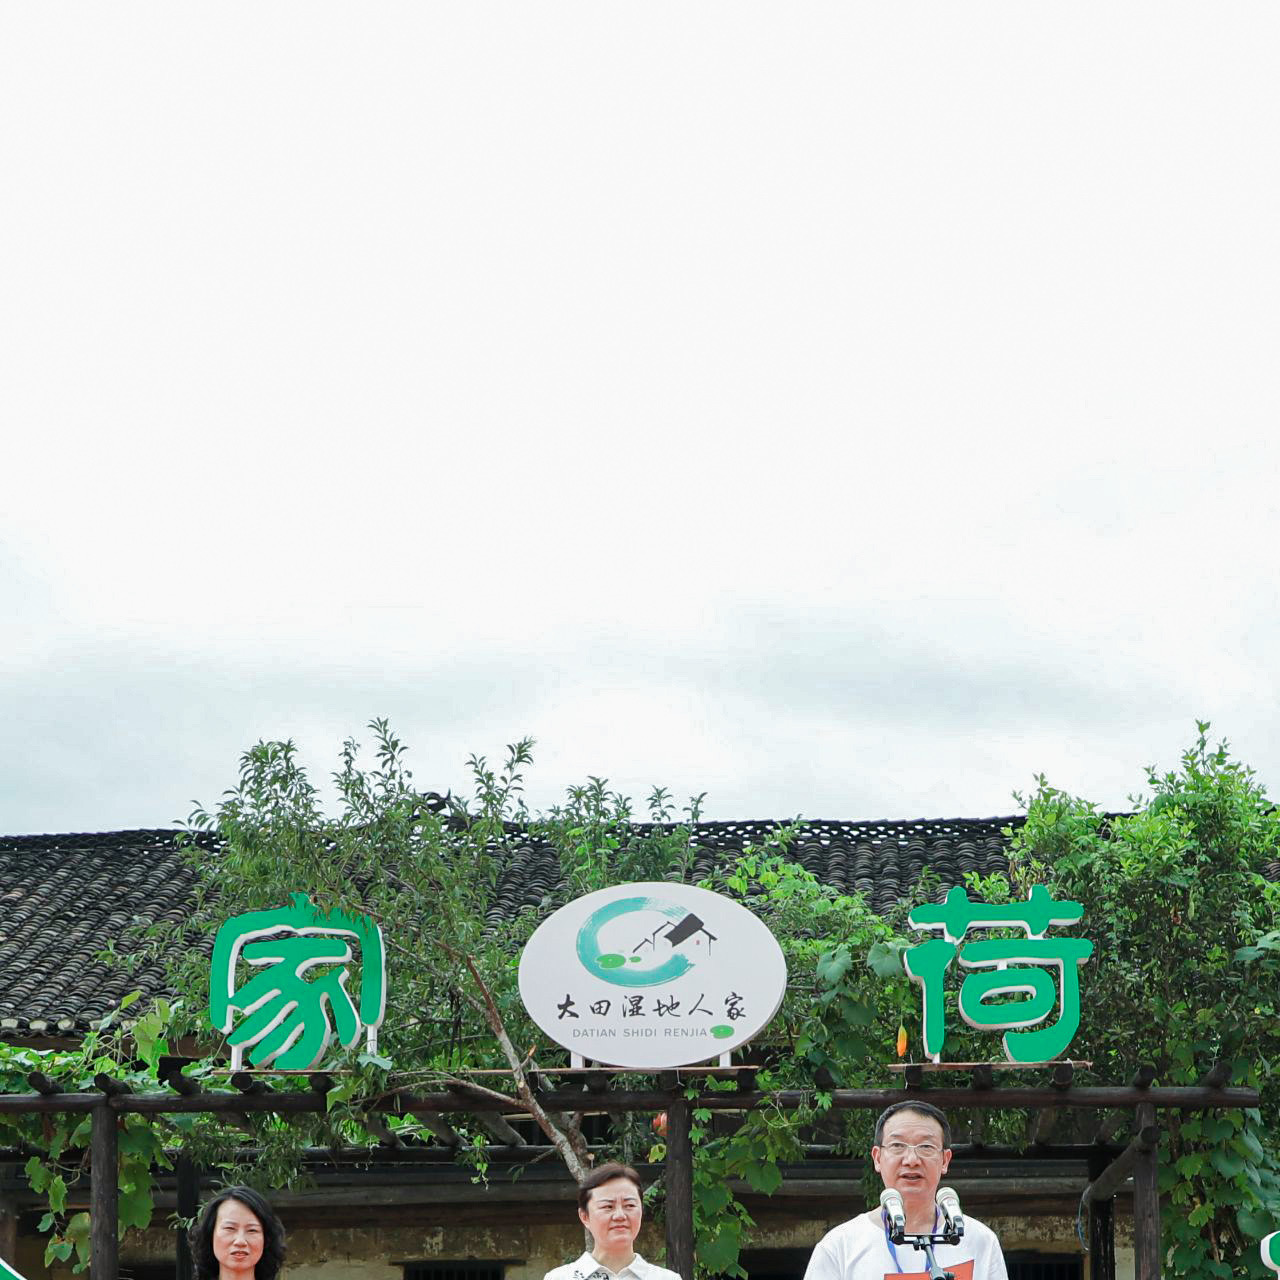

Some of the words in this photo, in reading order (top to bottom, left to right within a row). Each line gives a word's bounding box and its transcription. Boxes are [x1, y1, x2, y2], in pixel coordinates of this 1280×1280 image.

[210, 891, 387, 1071] 家
[556, 991, 747, 1021] 大田湿地人家
[904, 883, 1094, 1063] 荷
[572, 1028, 617, 1038] DATIAN
[622, 1028, 657, 1038] SHIDI
[664, 1027, 708, 1038] RENJIA
